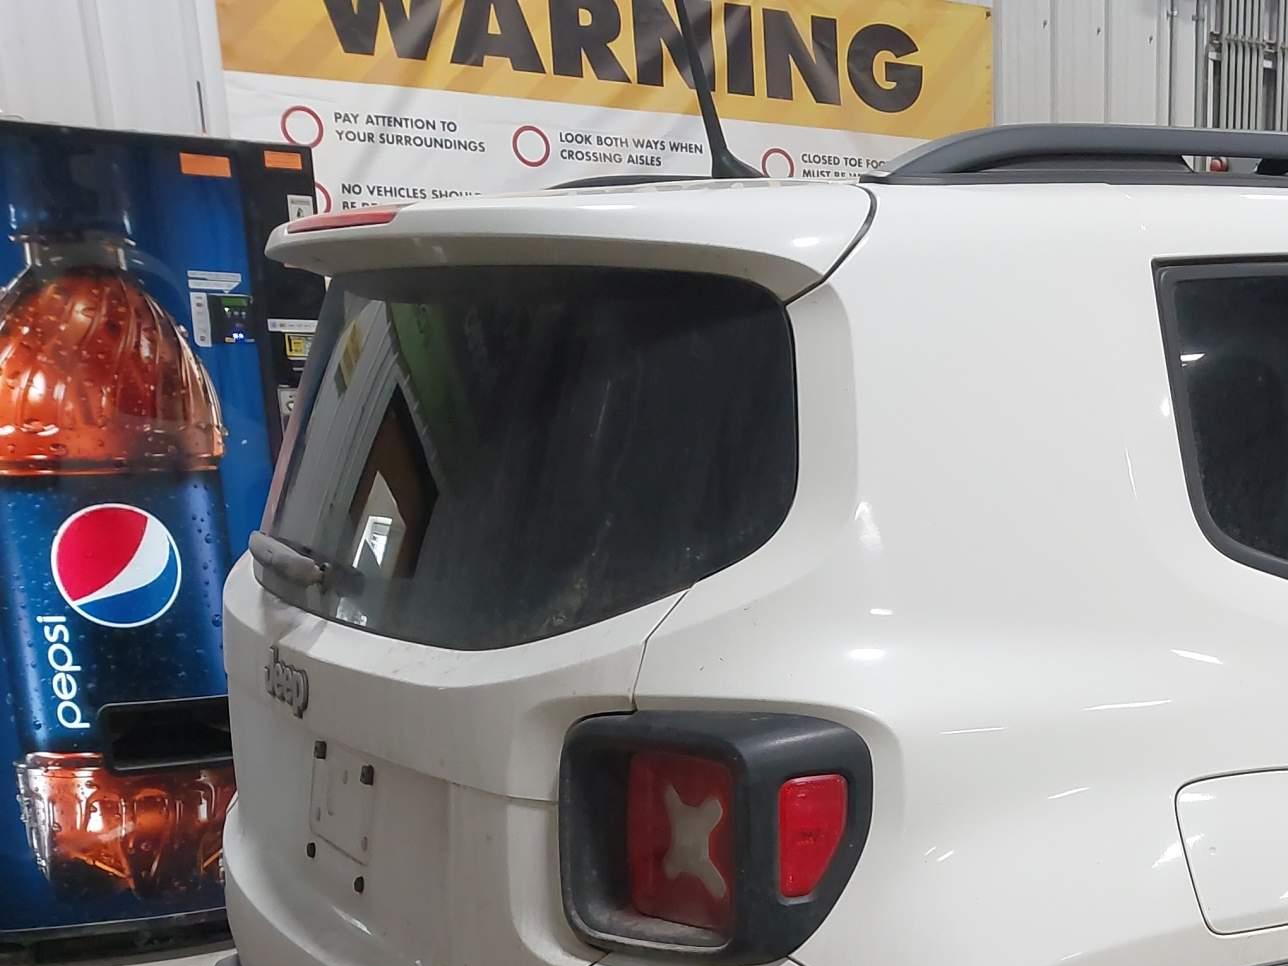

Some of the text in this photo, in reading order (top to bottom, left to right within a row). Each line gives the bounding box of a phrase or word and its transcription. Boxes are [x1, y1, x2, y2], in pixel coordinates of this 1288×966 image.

[322, 0, 924, 113] WARNING
[334, 112, 457, 133] PAY ATTENTION TO
[336, 130, 486, 153] YOUR SURROUNDINGS
[559, 132, 704, 154] LOOK BOTH WAYS WHEN
[560, 149, 662, 167] CROSSING AISLES
[801, 153, 841, 166] CLOSED
[843, 157, 863, 168] TOE
[341, 183, 362, 196] NO
[366, 185, 427, 200] VEHICLES
[36, 615, 91, 729] pepsi
[264, 645, 310, 720] Jeep
